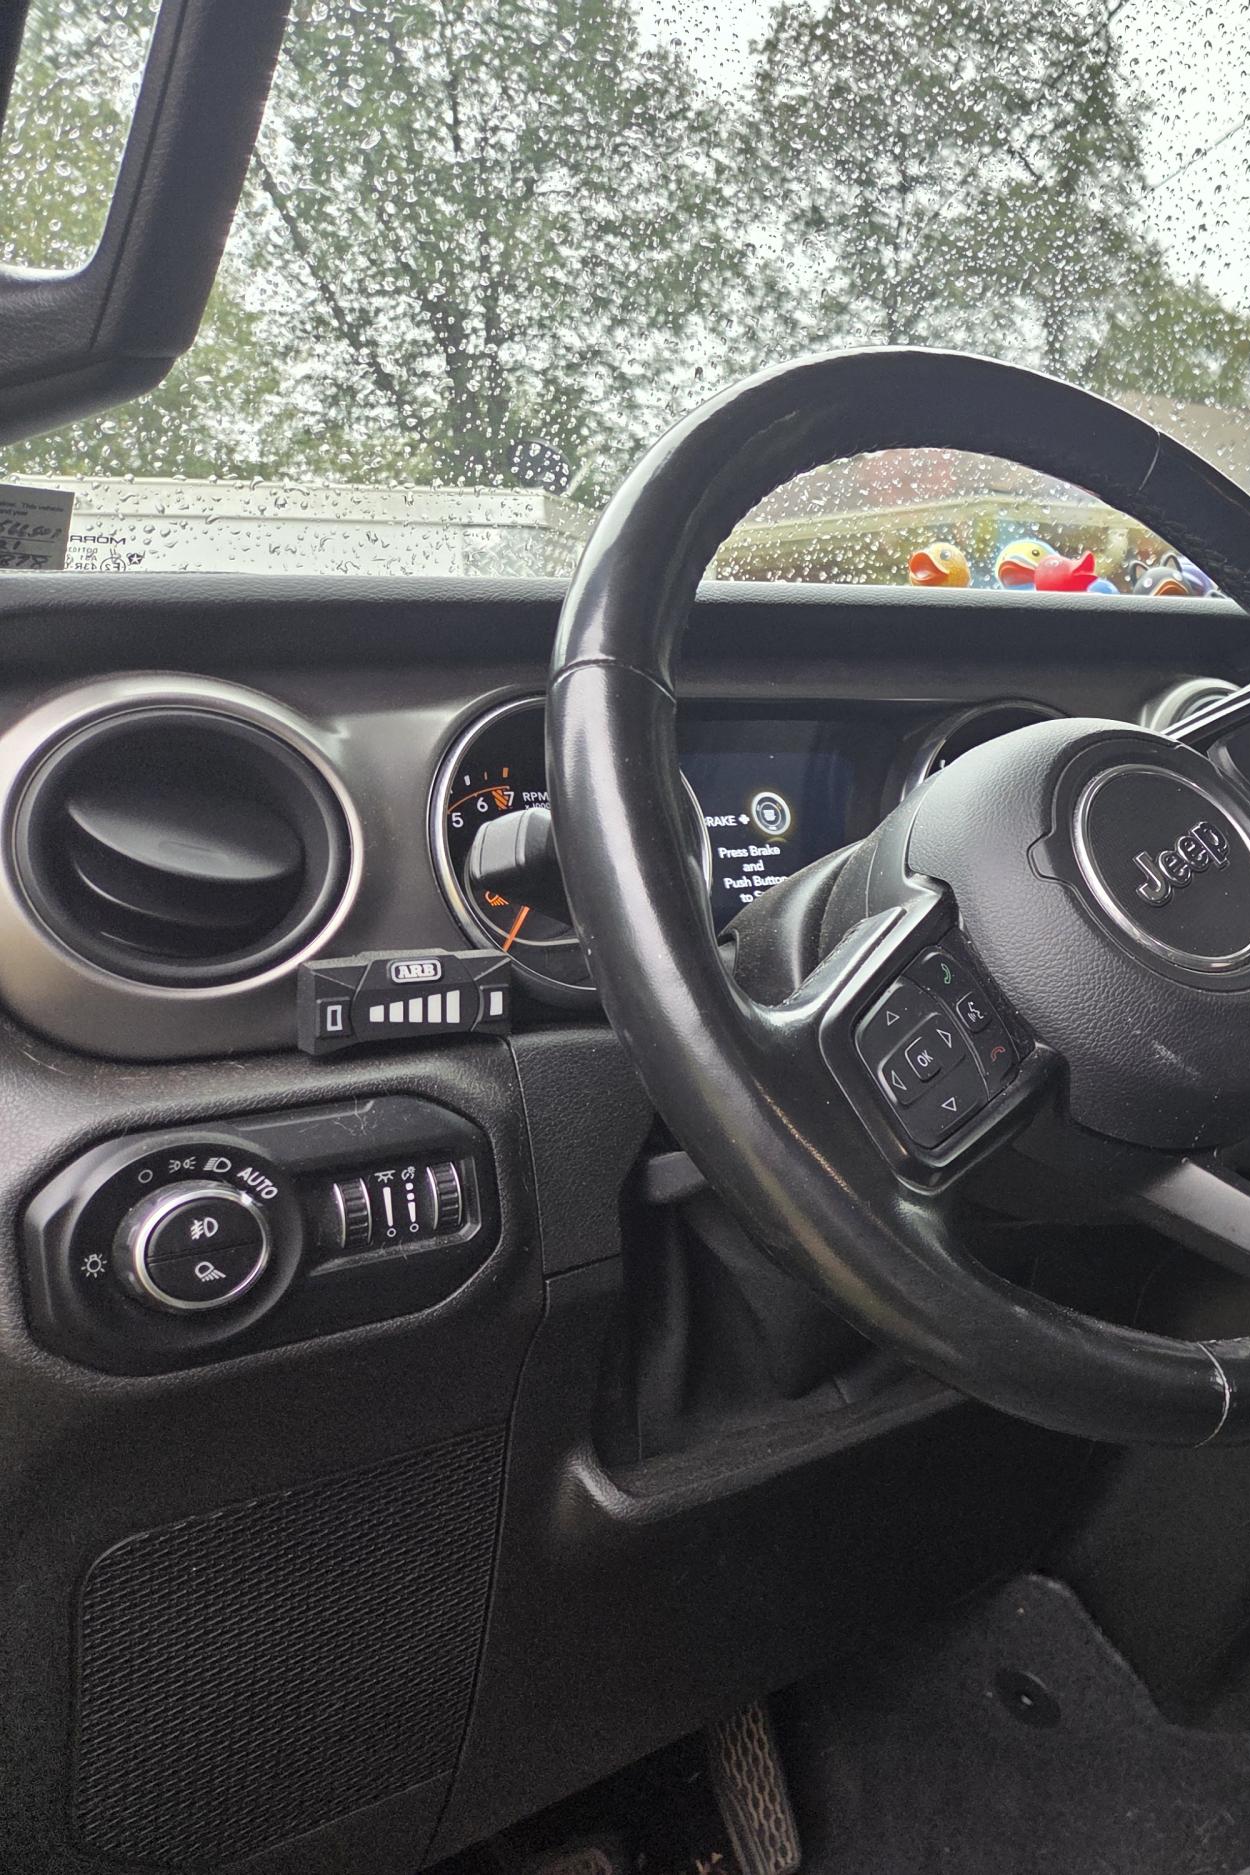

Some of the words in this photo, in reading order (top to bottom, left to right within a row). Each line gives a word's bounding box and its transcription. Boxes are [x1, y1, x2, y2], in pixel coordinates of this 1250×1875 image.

[503, 791, 514, 806] 7
[522, 791, 550, 802] RPM
[476, 797, 489, 813] 6
[451, 812, 464, 828] 5
[718, 847, 749, 859] Press
[748, 844, 781, 857] Brake
[742, 860, 765, 872] and
[1133, 821, 1231, 907] Jeep
[723, 876, 752, 889] Push
[739, 893, 754, 903] to
[398, 965, 437, 979] ARB
[917, 1049, 935, 1068] OK
[236, 1167, 279, 1199] AUTO
